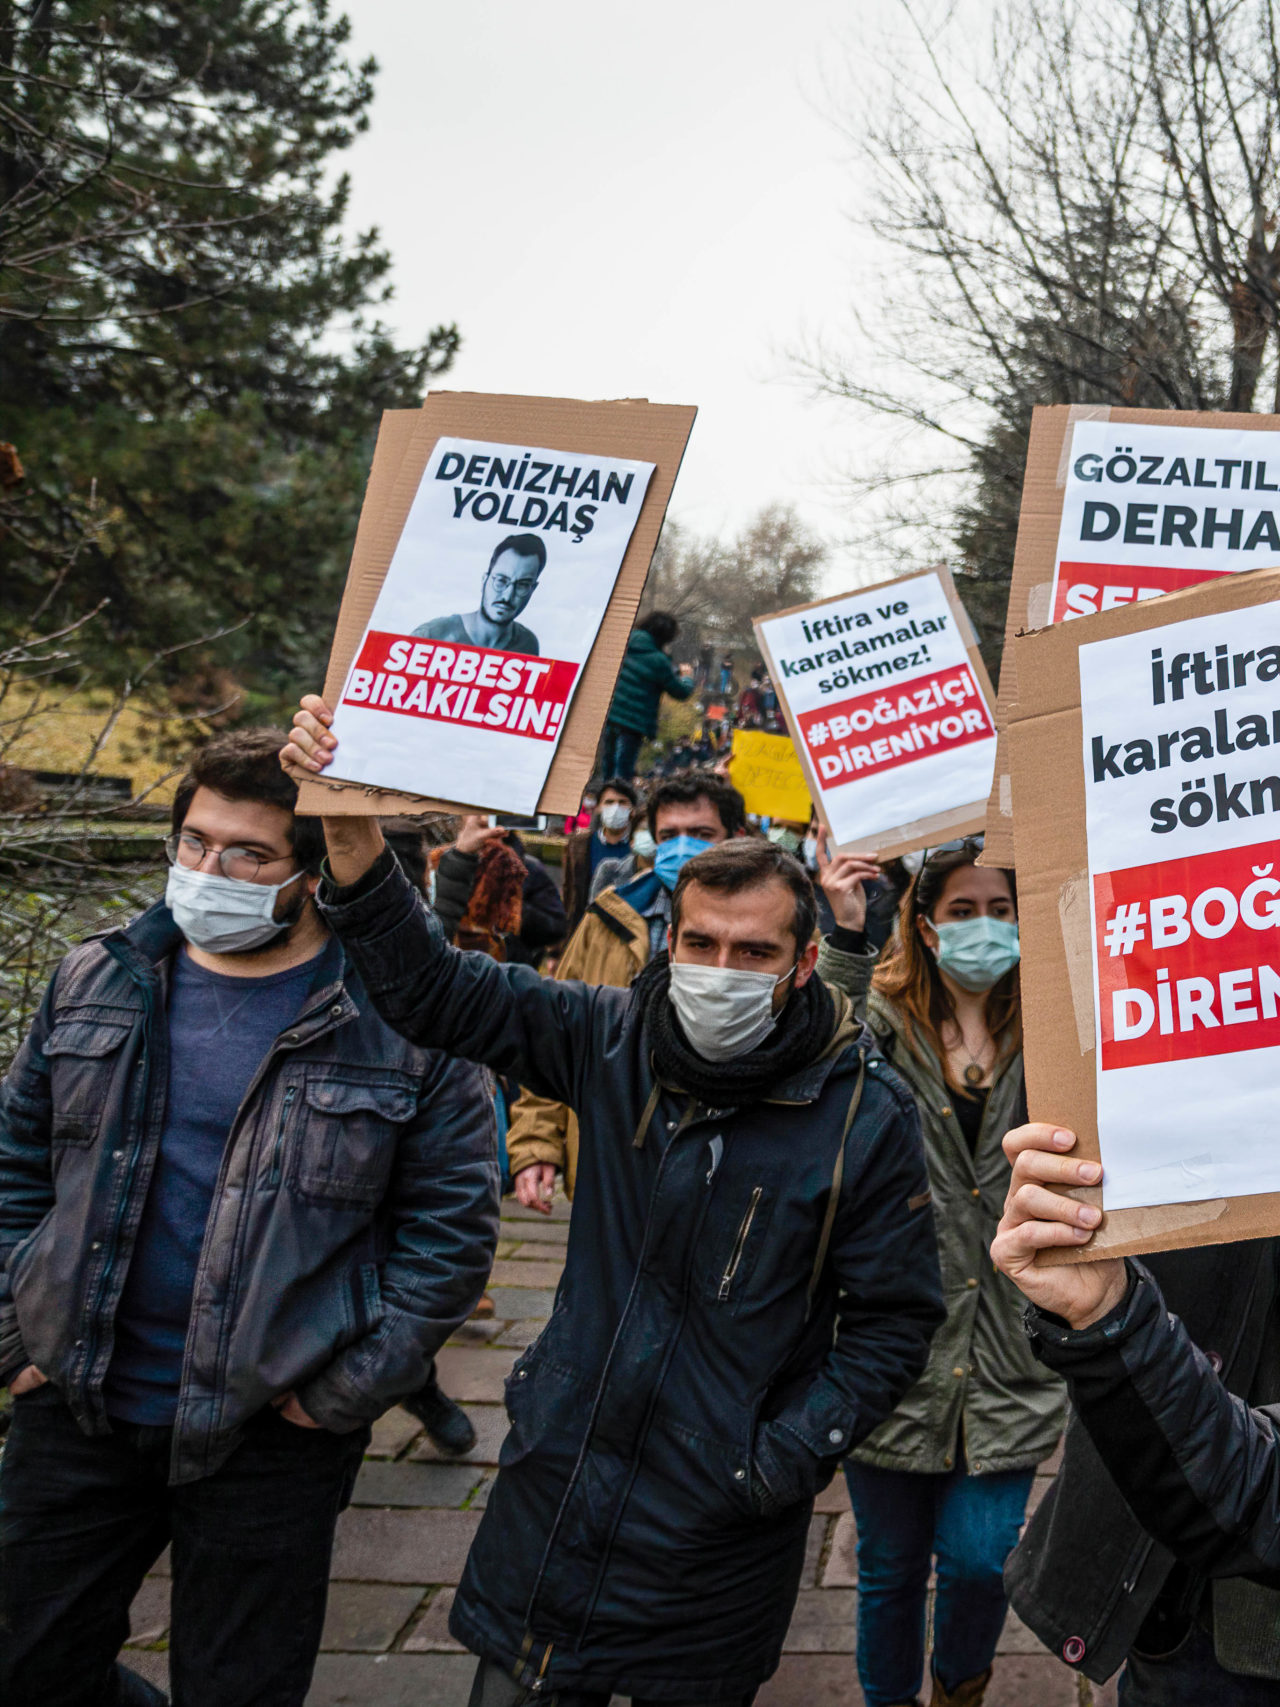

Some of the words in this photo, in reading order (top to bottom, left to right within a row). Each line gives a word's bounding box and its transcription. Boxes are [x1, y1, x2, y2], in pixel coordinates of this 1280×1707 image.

[435, 452, 635, 504] DENİZHAN
[452, 487, 599, 544] YOLDAŞ
[801, 609, 872, 643] İftira
[876, 600, 909, 621] ve
[1062, 583, 1168, 621] SE
[383, 640, 550, 695] SERBEST
[780, 614, 948, 678] karalamalar
[818, 644, 932, 694] sökmez!
[345, 669, 564, 737] BIRAKILSIN!
[807, 671, 976, 747] #BOĞAZİÇİ
[818, 709, 987, 780] DİRENİYOR
